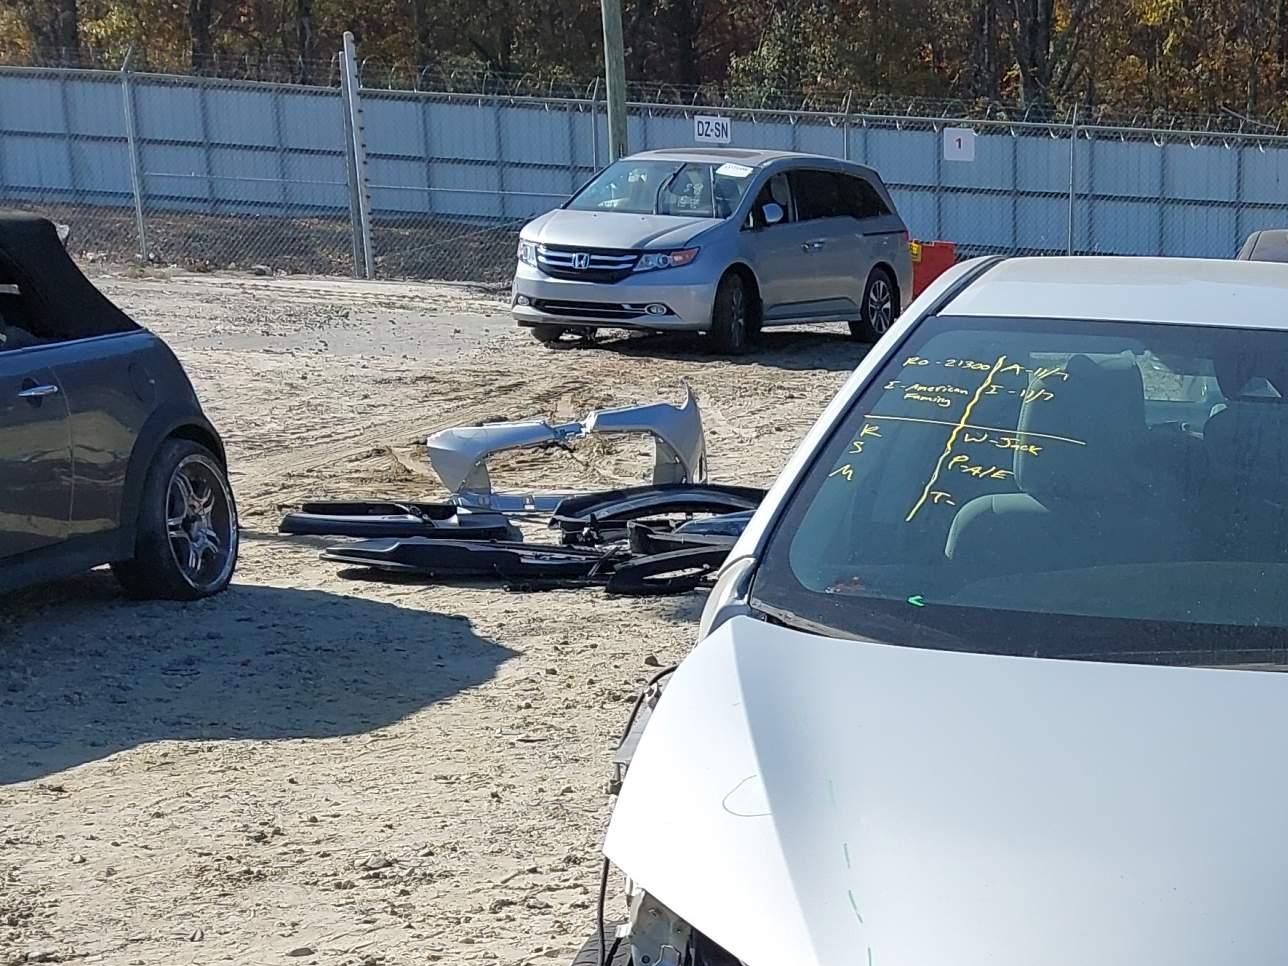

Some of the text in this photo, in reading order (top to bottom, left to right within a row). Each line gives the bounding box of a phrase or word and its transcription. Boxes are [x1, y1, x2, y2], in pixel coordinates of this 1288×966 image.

[697, 120, 728, 139] DZ-SN
[955, 137, 962, 150] 1
[848, 440, 865, 454] S
